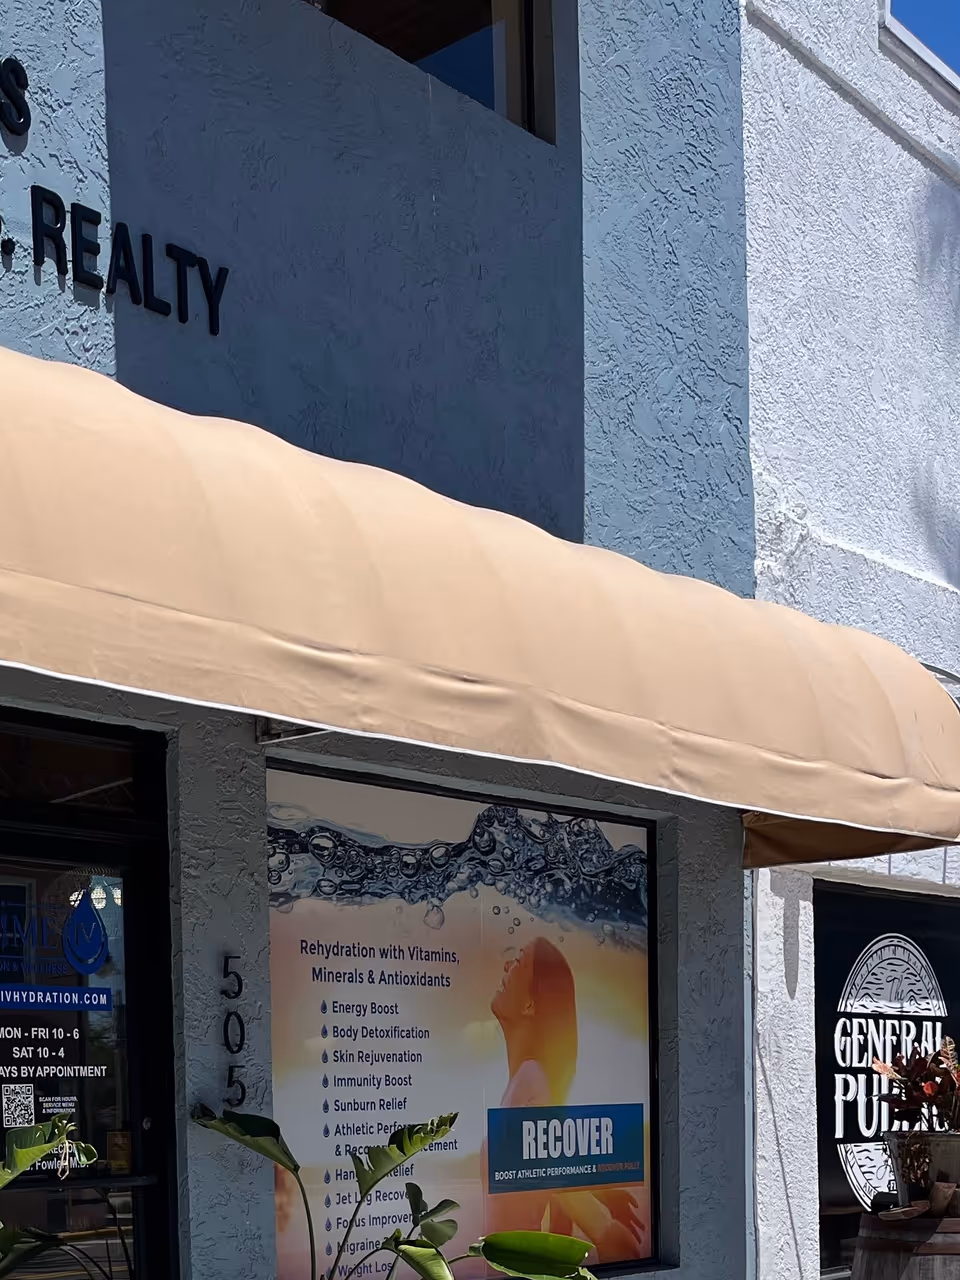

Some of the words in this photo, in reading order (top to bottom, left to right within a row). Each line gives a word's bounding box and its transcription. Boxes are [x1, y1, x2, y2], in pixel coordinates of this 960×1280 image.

[30, 185, 230, 336] REALTY
[300, 940, 375, 959] Rehydration
[379, 944, 405, 960] with
[408, 947, 460, 965] Vitamins,
[312, 967, 364, 984] Minerals
[367, 969, 375, 985] &
[378, 970, 451, 987] Antioxidants
[332, 1001, 368, 1017] Energy
[371, 1002, 399, 1015] Boost
[31, 1027, 49, 1039] FRI
[51, 1028, 64, 1039] 10
[73, 1028, 80, 1039] 6
[333, 1026, 358, 1041] Body
[361, 1026, 430, 1039] Detoxification
[12, 1047, 34, 1059] SAT
[36, 1047, 49, 1059] 10
[58, 1047, 65, 1059] 4
[333, 1050, 354, 1063] Skin
[357, 1050, 422, 1066] Rejuvenation
[20, 1066, 34, 1078] BY
[35, 1065, 107, 1078] APPOINTMENT
[333, 1074, 382, 1089] Immunity
[384, 1074, 412, 1086] Boost
[334, 1099, 376, 1112] Sunburn
[379, 1097, 407, 1110] Relief
[334, 1123, 374, 1136] Athletic
[522, 1117, 613, 1160] RECOVER
[335, 1144, 341, 1156] &
[495, 1168, 516, 1180] BOOST
[517, 1169, 546, 1179] ATHLETIC
[547, 1165, 591, 1177] PERFORMANCE
[336, 1193, 352, 1205] Jet
[355, 1191, 372, 1205] Lg
[336, 1217, 365, 1229] Fous
